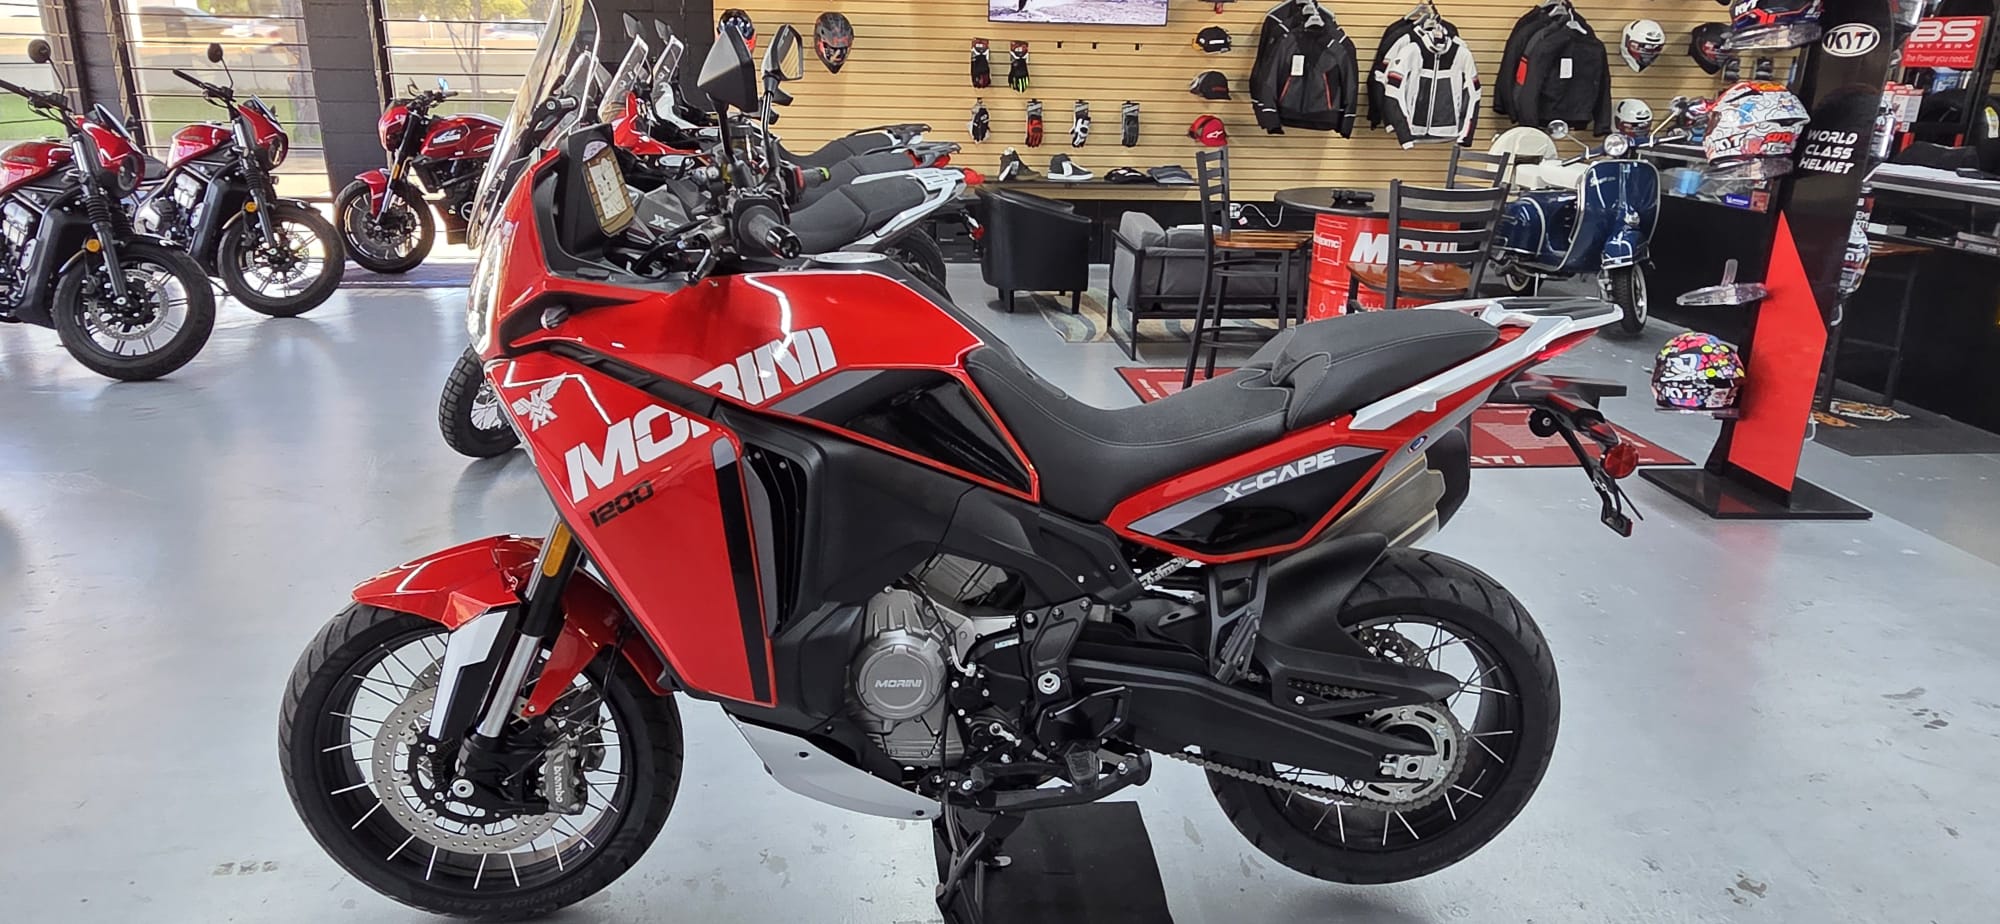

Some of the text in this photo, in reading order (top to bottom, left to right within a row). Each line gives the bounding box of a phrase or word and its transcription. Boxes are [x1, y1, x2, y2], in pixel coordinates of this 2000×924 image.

[1826, 30, 1874, 50] KYT
[1909, 19, 1978, 43] BS
[1807, 129, 1858, 145] WORLD
[1804, 143, 1854, 160] CLASS
[1799, 156, 1855, 175] HELMET
[564, 326, 838, 505] MORINI
[1223, 448, 1336, 503] X-CAPE
[588, 479, 655, 529] 1200
[874, 679, 922, 689] MORINI
[553, 765, 565, 803] brembo
